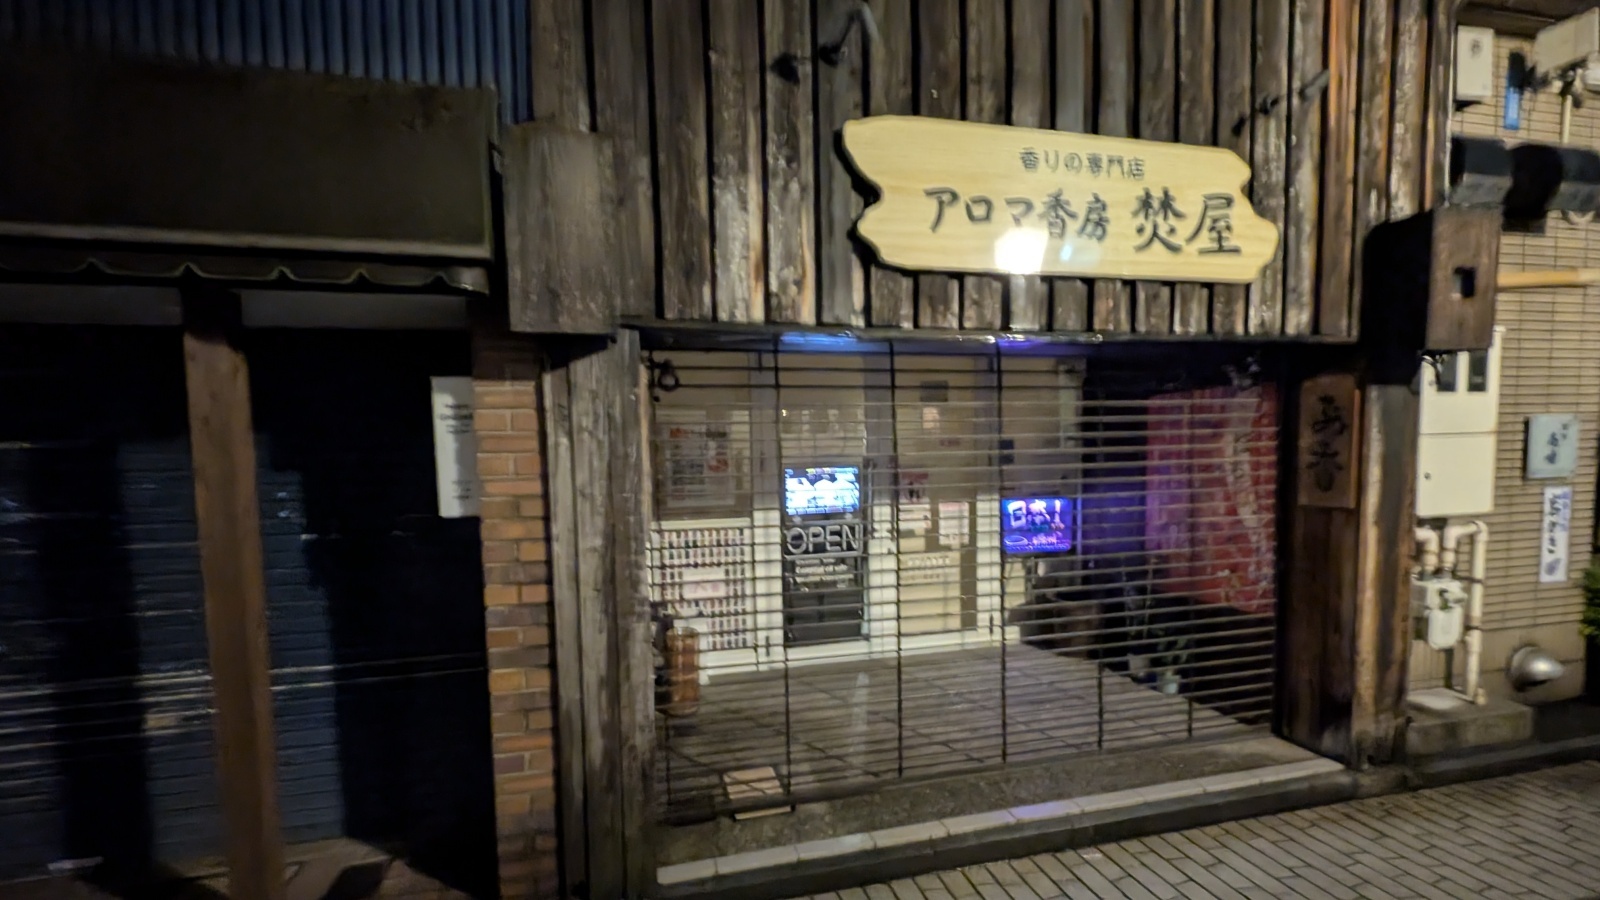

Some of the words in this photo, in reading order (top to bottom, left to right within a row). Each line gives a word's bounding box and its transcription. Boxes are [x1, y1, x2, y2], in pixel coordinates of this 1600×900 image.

[923, 187, 1110, 242] アロマ香房
[1131, 187, 1242, 255] 焚屋
[786, 525, 856, 556] OPEN
